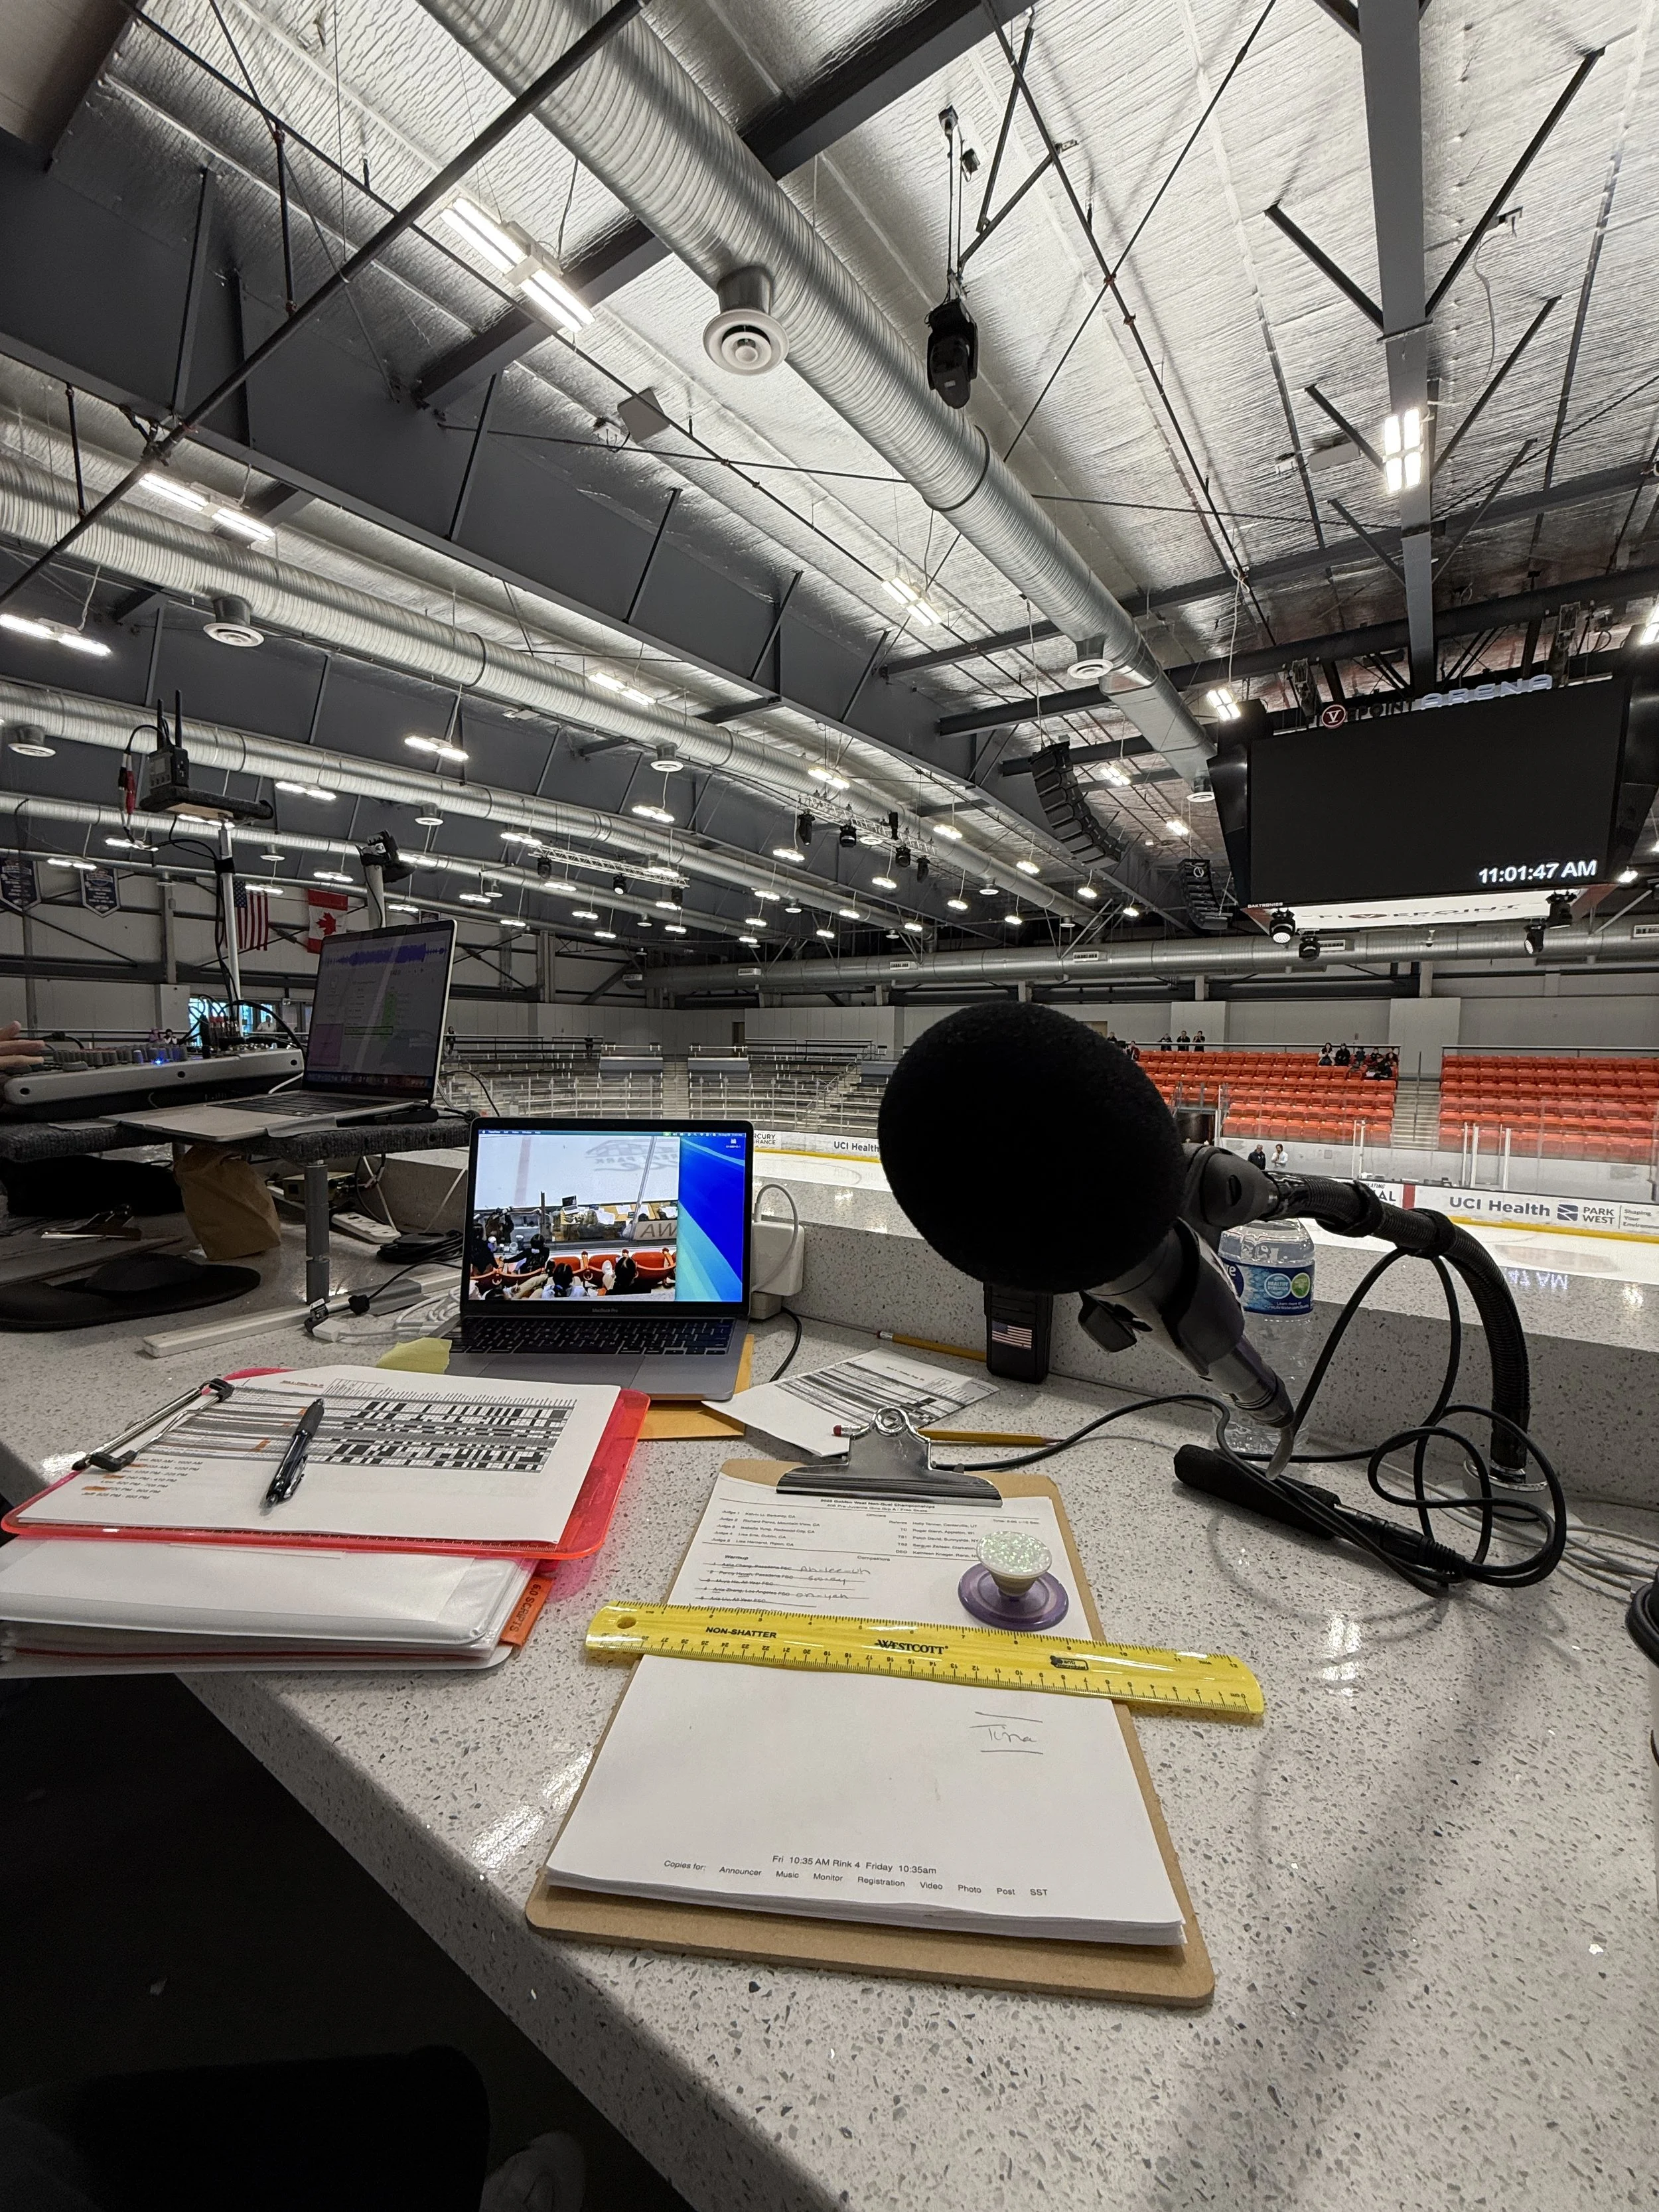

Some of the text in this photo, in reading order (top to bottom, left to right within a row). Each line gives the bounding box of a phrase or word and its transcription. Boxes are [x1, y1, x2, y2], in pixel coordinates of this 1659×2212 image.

[1421, 674, 1552, 710] ARENA
[1479, 859, 1597, 883] 11:01:47 AM
[834, 1141, 880, 1152] UCI Health
[1449, 1197, 1550, 1217] UCI Health
[1583, 1207, 1614, 1216] PARK
[1583, 1215, 1615, 1224] WEST
[530, 1584, 541, 1595] 6.0
[705, 1627, 776, 1639] NON-SHATTER
[875, 1639, 944, 1655] WESTCOTT
[790, 1856, 814, 1865] 10:35
[865, 1862, 893, 1873] Friday
[899, 1865, 937, 1874] 10:35am
[664, 1860, 691, 1870] Copies
[693, 1862, 706, 1871] for:
[719, 1866, 762, 1876] Announcer
[776, 1870, 799, 1879] Music
[814, 1873, 843, 1882] Monitor
[857, 1876, 905, 1887] Registration
[920, 1881, 943, 1890] Video
[958, 1884, 981, 1893] Photo
